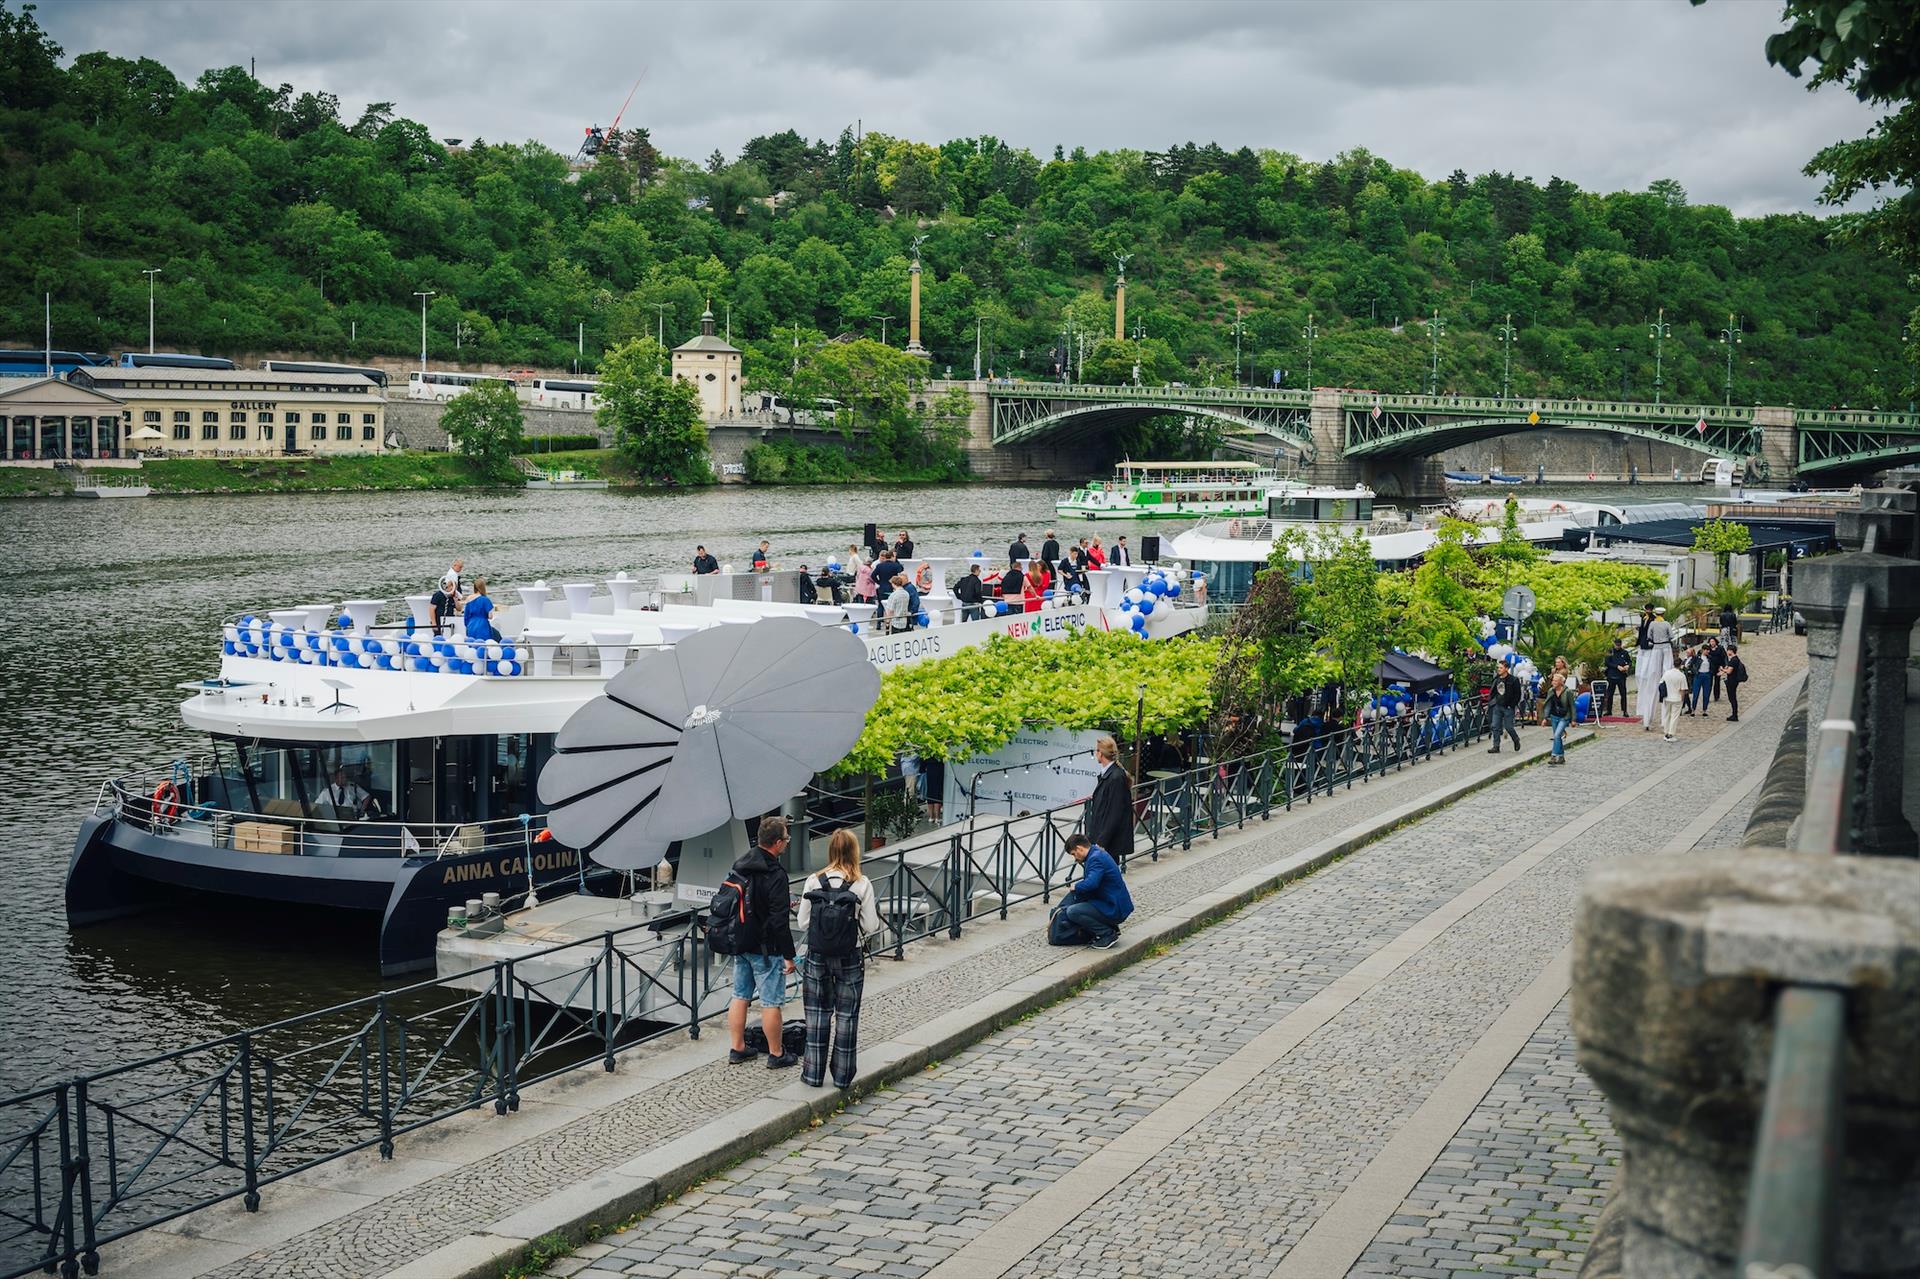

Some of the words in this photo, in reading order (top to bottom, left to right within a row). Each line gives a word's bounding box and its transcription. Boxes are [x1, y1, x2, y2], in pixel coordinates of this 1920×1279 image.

[231, 401, 277, 410] GALLERY
[1797, 548, 1804, 557] 2
[1008, 622, 1029, 638] NEW
[1505, 626, 1512, 640] 1
[870, 643, 901, 664] AGUE
[904, 636, 941, 658] BOATS
[1015, 737, 1049, 746] ELECTRIC
[1063, 767, 1097, 778] ELECTRIC
[1014, 792, 1047, 802] ELECTRIC
[443, 861, 494, 884] ANNA
